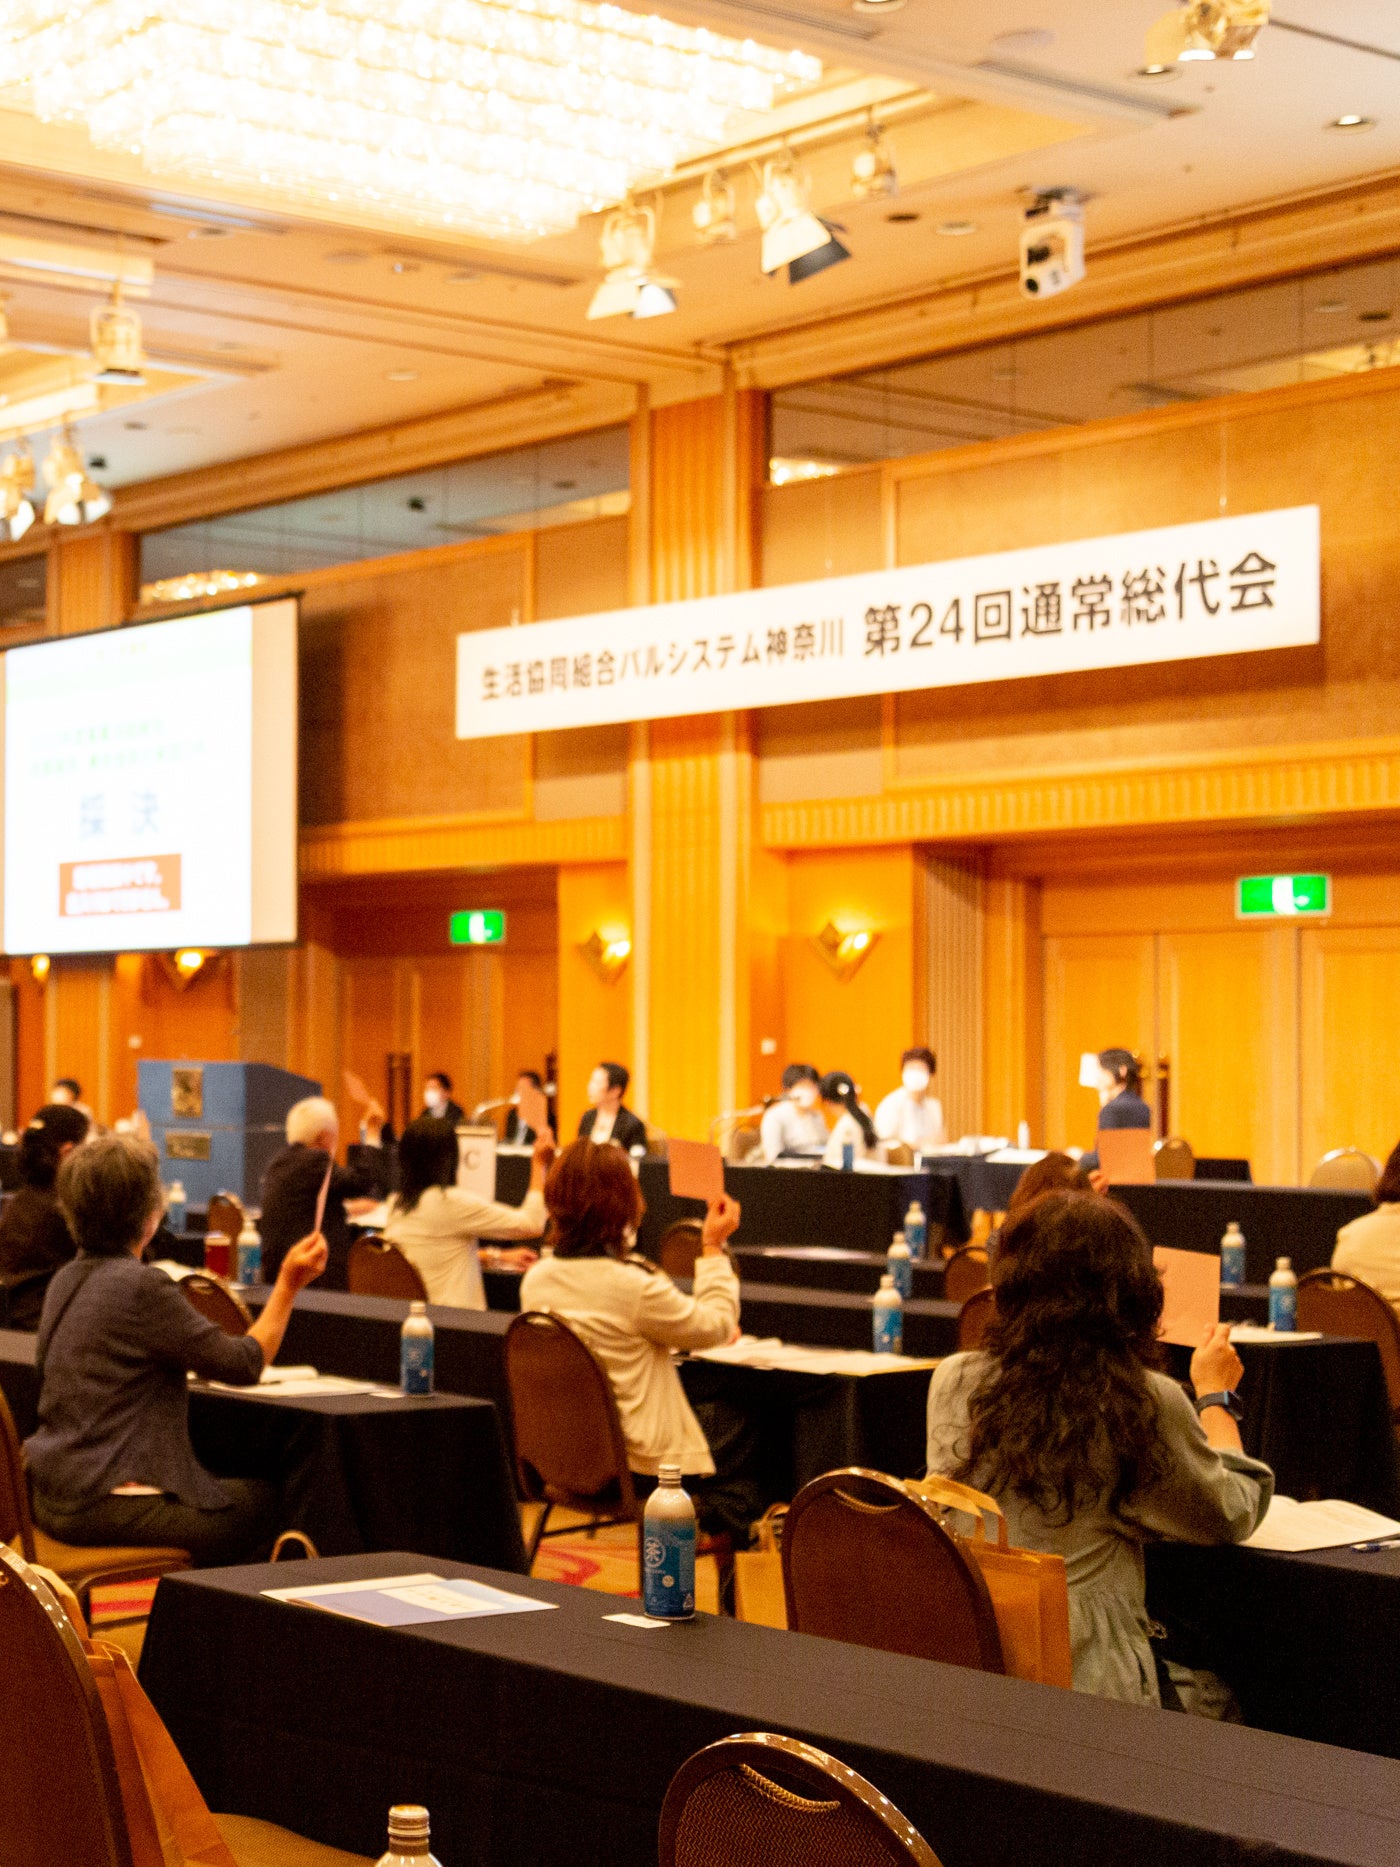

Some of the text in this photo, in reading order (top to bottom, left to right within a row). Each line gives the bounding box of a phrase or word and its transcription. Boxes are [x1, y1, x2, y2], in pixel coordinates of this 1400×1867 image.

[863, 551, 1277, 658] 第24回通常総代会
